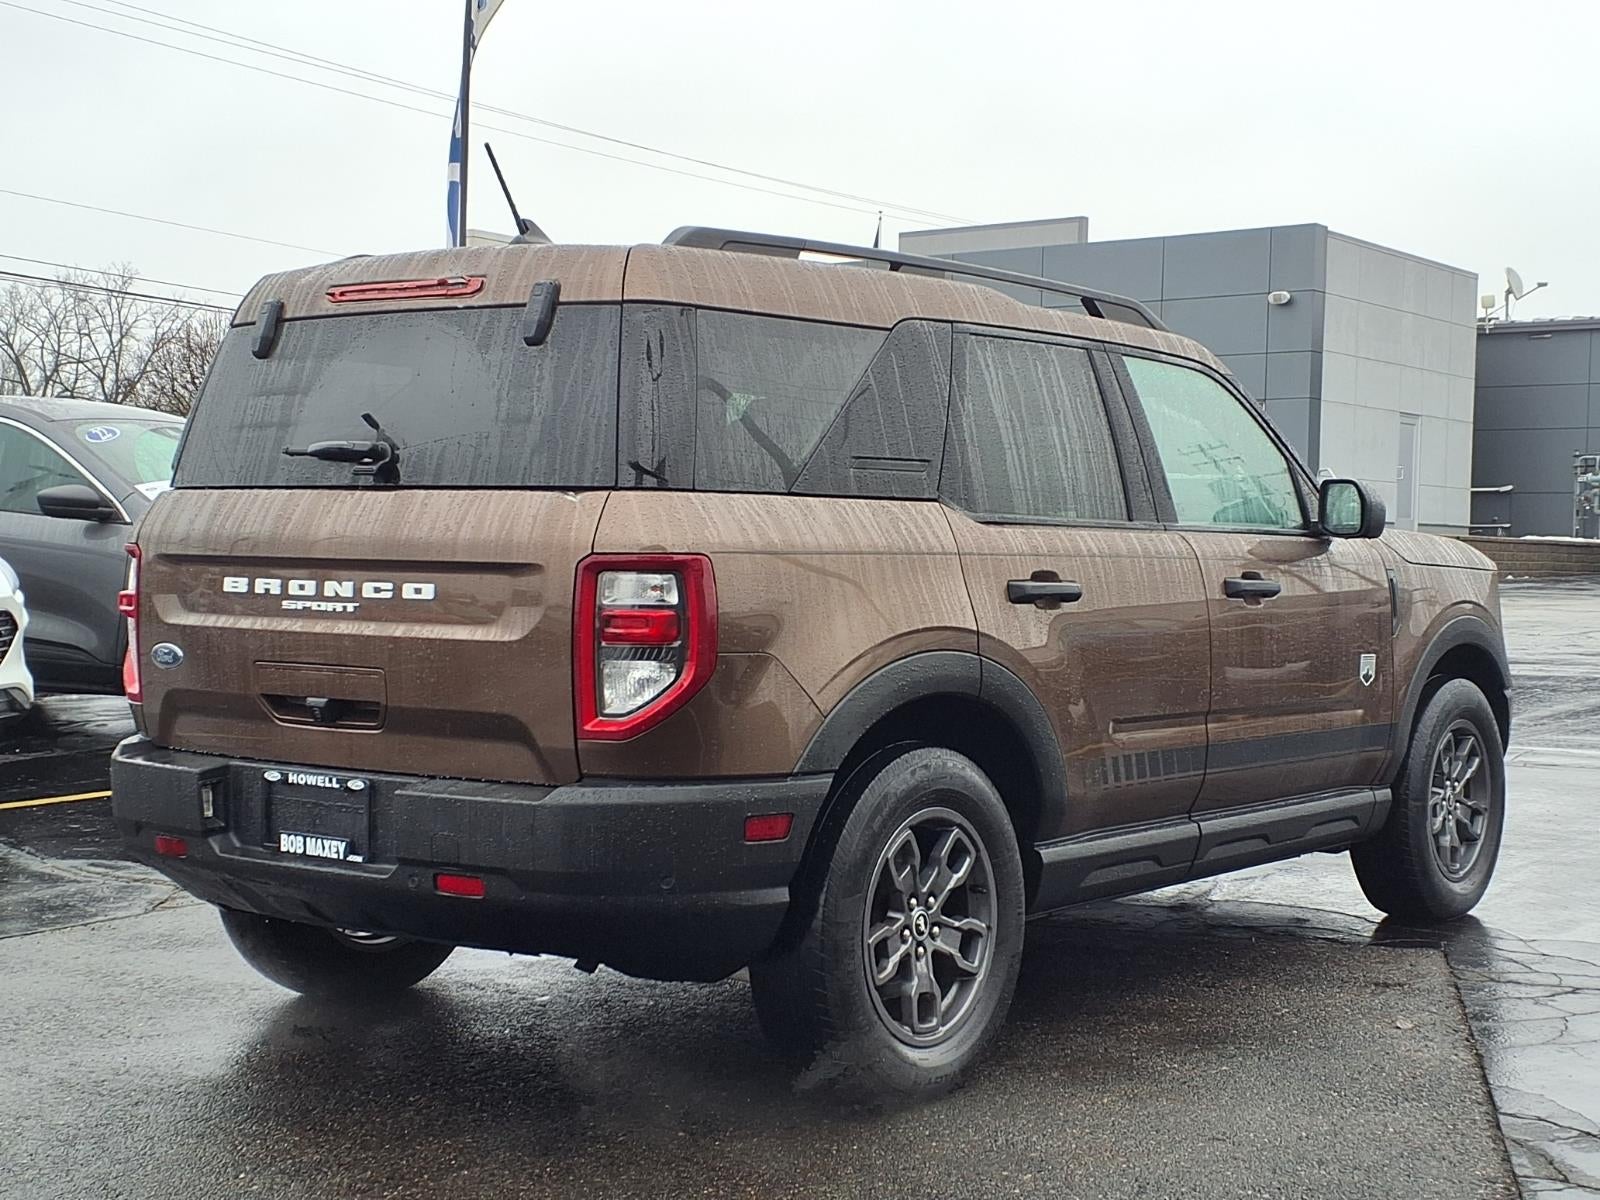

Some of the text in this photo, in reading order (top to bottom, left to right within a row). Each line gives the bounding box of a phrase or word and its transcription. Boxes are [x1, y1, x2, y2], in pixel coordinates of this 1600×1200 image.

[223, 576, 436, 599] BRONCO
[281, 600, 360, 612] SPORT
[288, 772, 340, 788] HOWELL
[280, 834, 346, 860] BOB MAXEY
